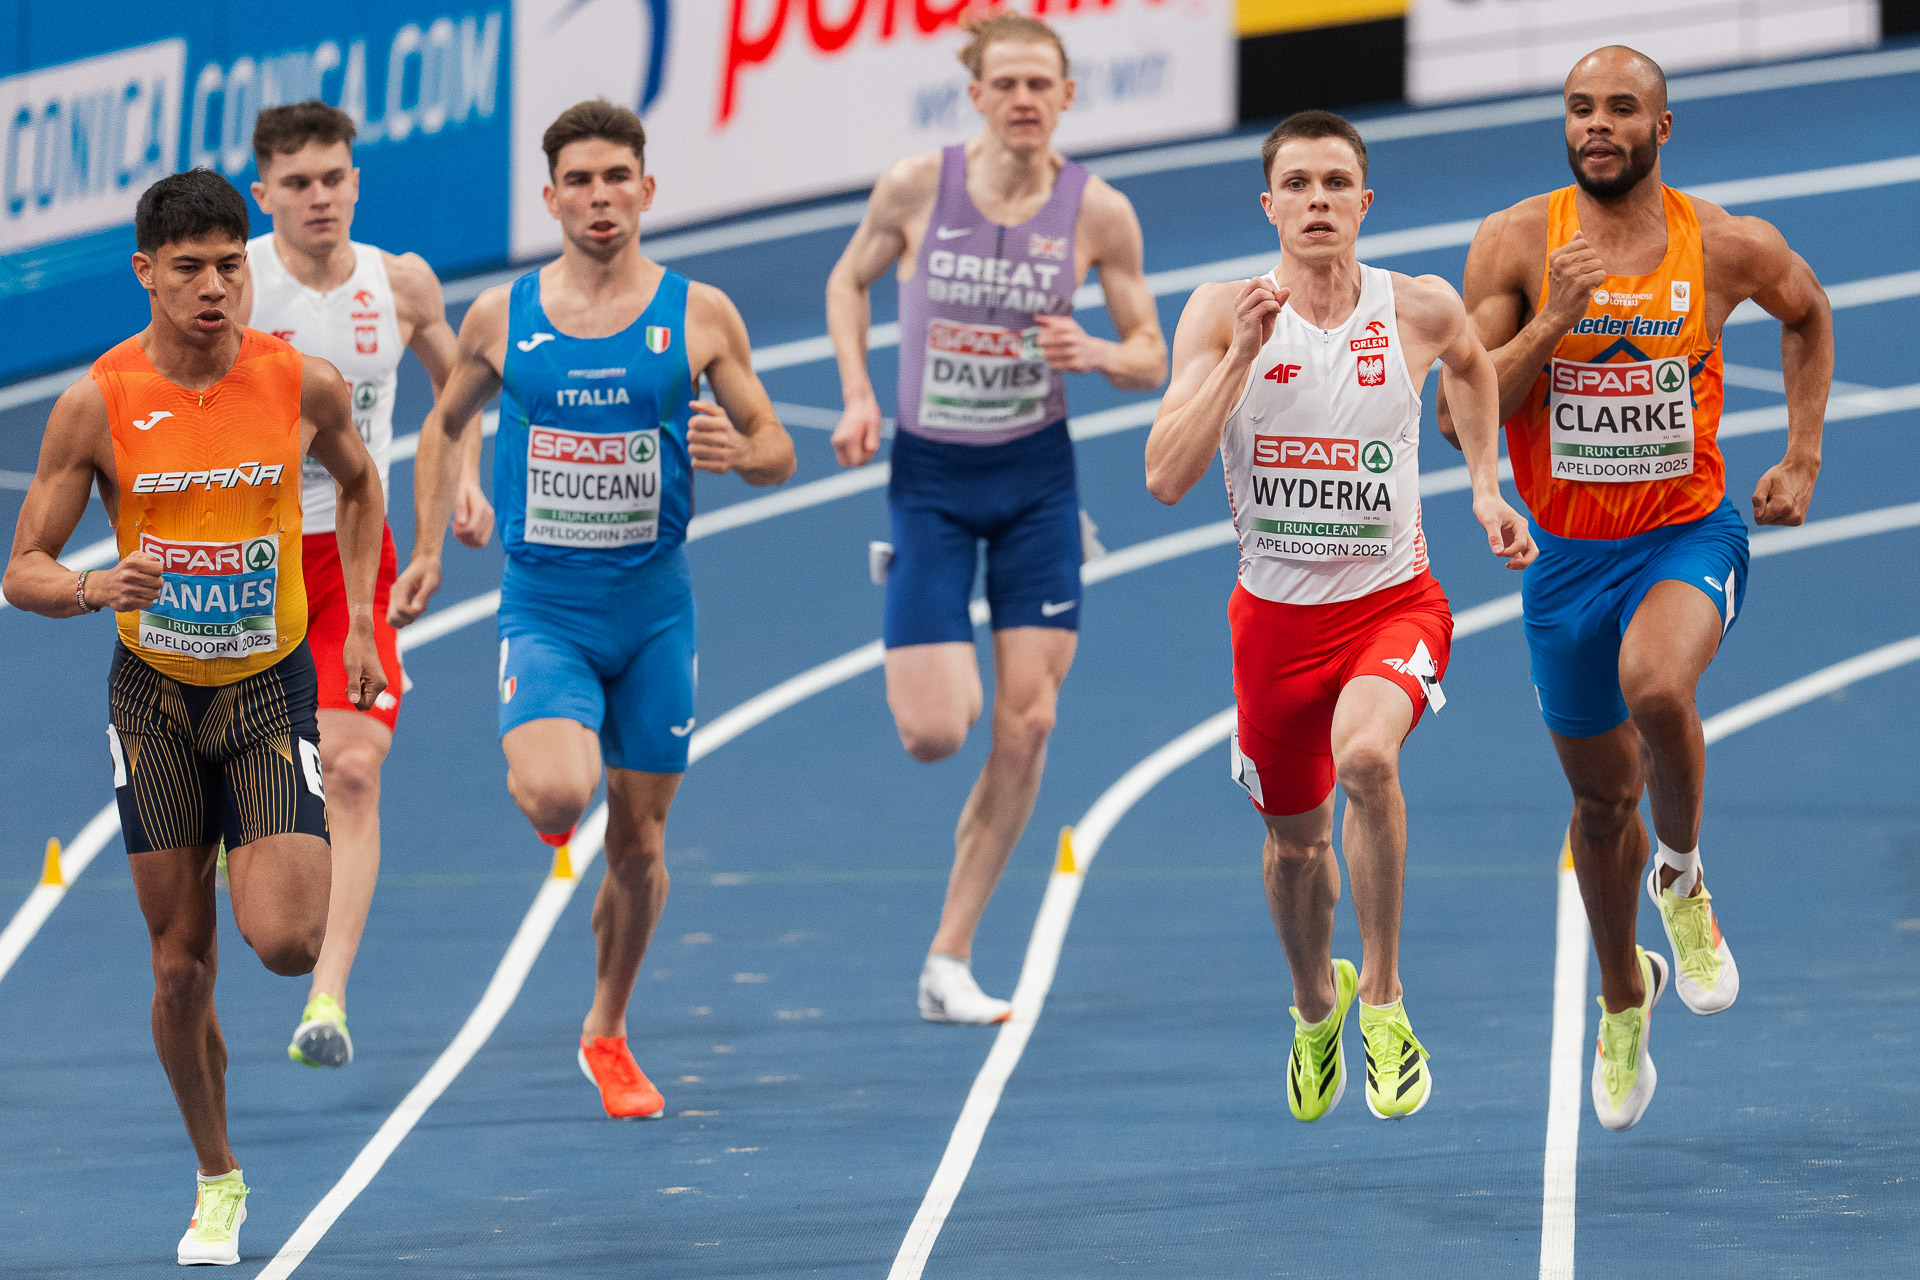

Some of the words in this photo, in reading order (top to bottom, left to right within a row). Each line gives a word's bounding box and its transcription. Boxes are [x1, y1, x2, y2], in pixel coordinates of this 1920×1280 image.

[4, 82, 168, 219] CONICA
[928, 250, 1061, 290] GREAT
[1610, 292, 1653, 300] NEDERLANDSE
[932, 325, 1020, 357] SPAR
[1352, 338, 1386, 350] ORLEN
[933, 357, 1043, 389] DAVIES
[1264, 363, 1302, 384] 4F
[1556, 367, 1650, 392] SPAR
[557, 388, 630, 406] ITALIA
[1555, 400, 1686, 433] CLARKE
[533, 433, 624, 462] SPAR
[1256, 440, 1356, 466] SPAR
[1585, 447, 1613, 457] RUN
[132, 461, 284, 494] ESPAÑA
[1557, 461, 1650, 476] APELDOORN
[1655, 458, 1688, 474] 2025
[530, 468, 656, 500] TECUCEANU
[1252, 475, 1392, 512] WYDERKA
[558, 512, 584, 522] RUN
[1284, 522, 1312, 534] RUN
[531, 524, 620, 541] APELDOORN
[623, 526, 652, 540] 2025
[144, 543, 241, 571] SPAR
[1257, 537, 1349, 556] APELDOORN
[1352, 544, 1387, 557] 2025
[153, 578, 272, 613] ANALES
[174, 621, 200, 634] RUN
[144, 632, 238, 654] APELDOORN
[242, 635, 271, 651] 2025
